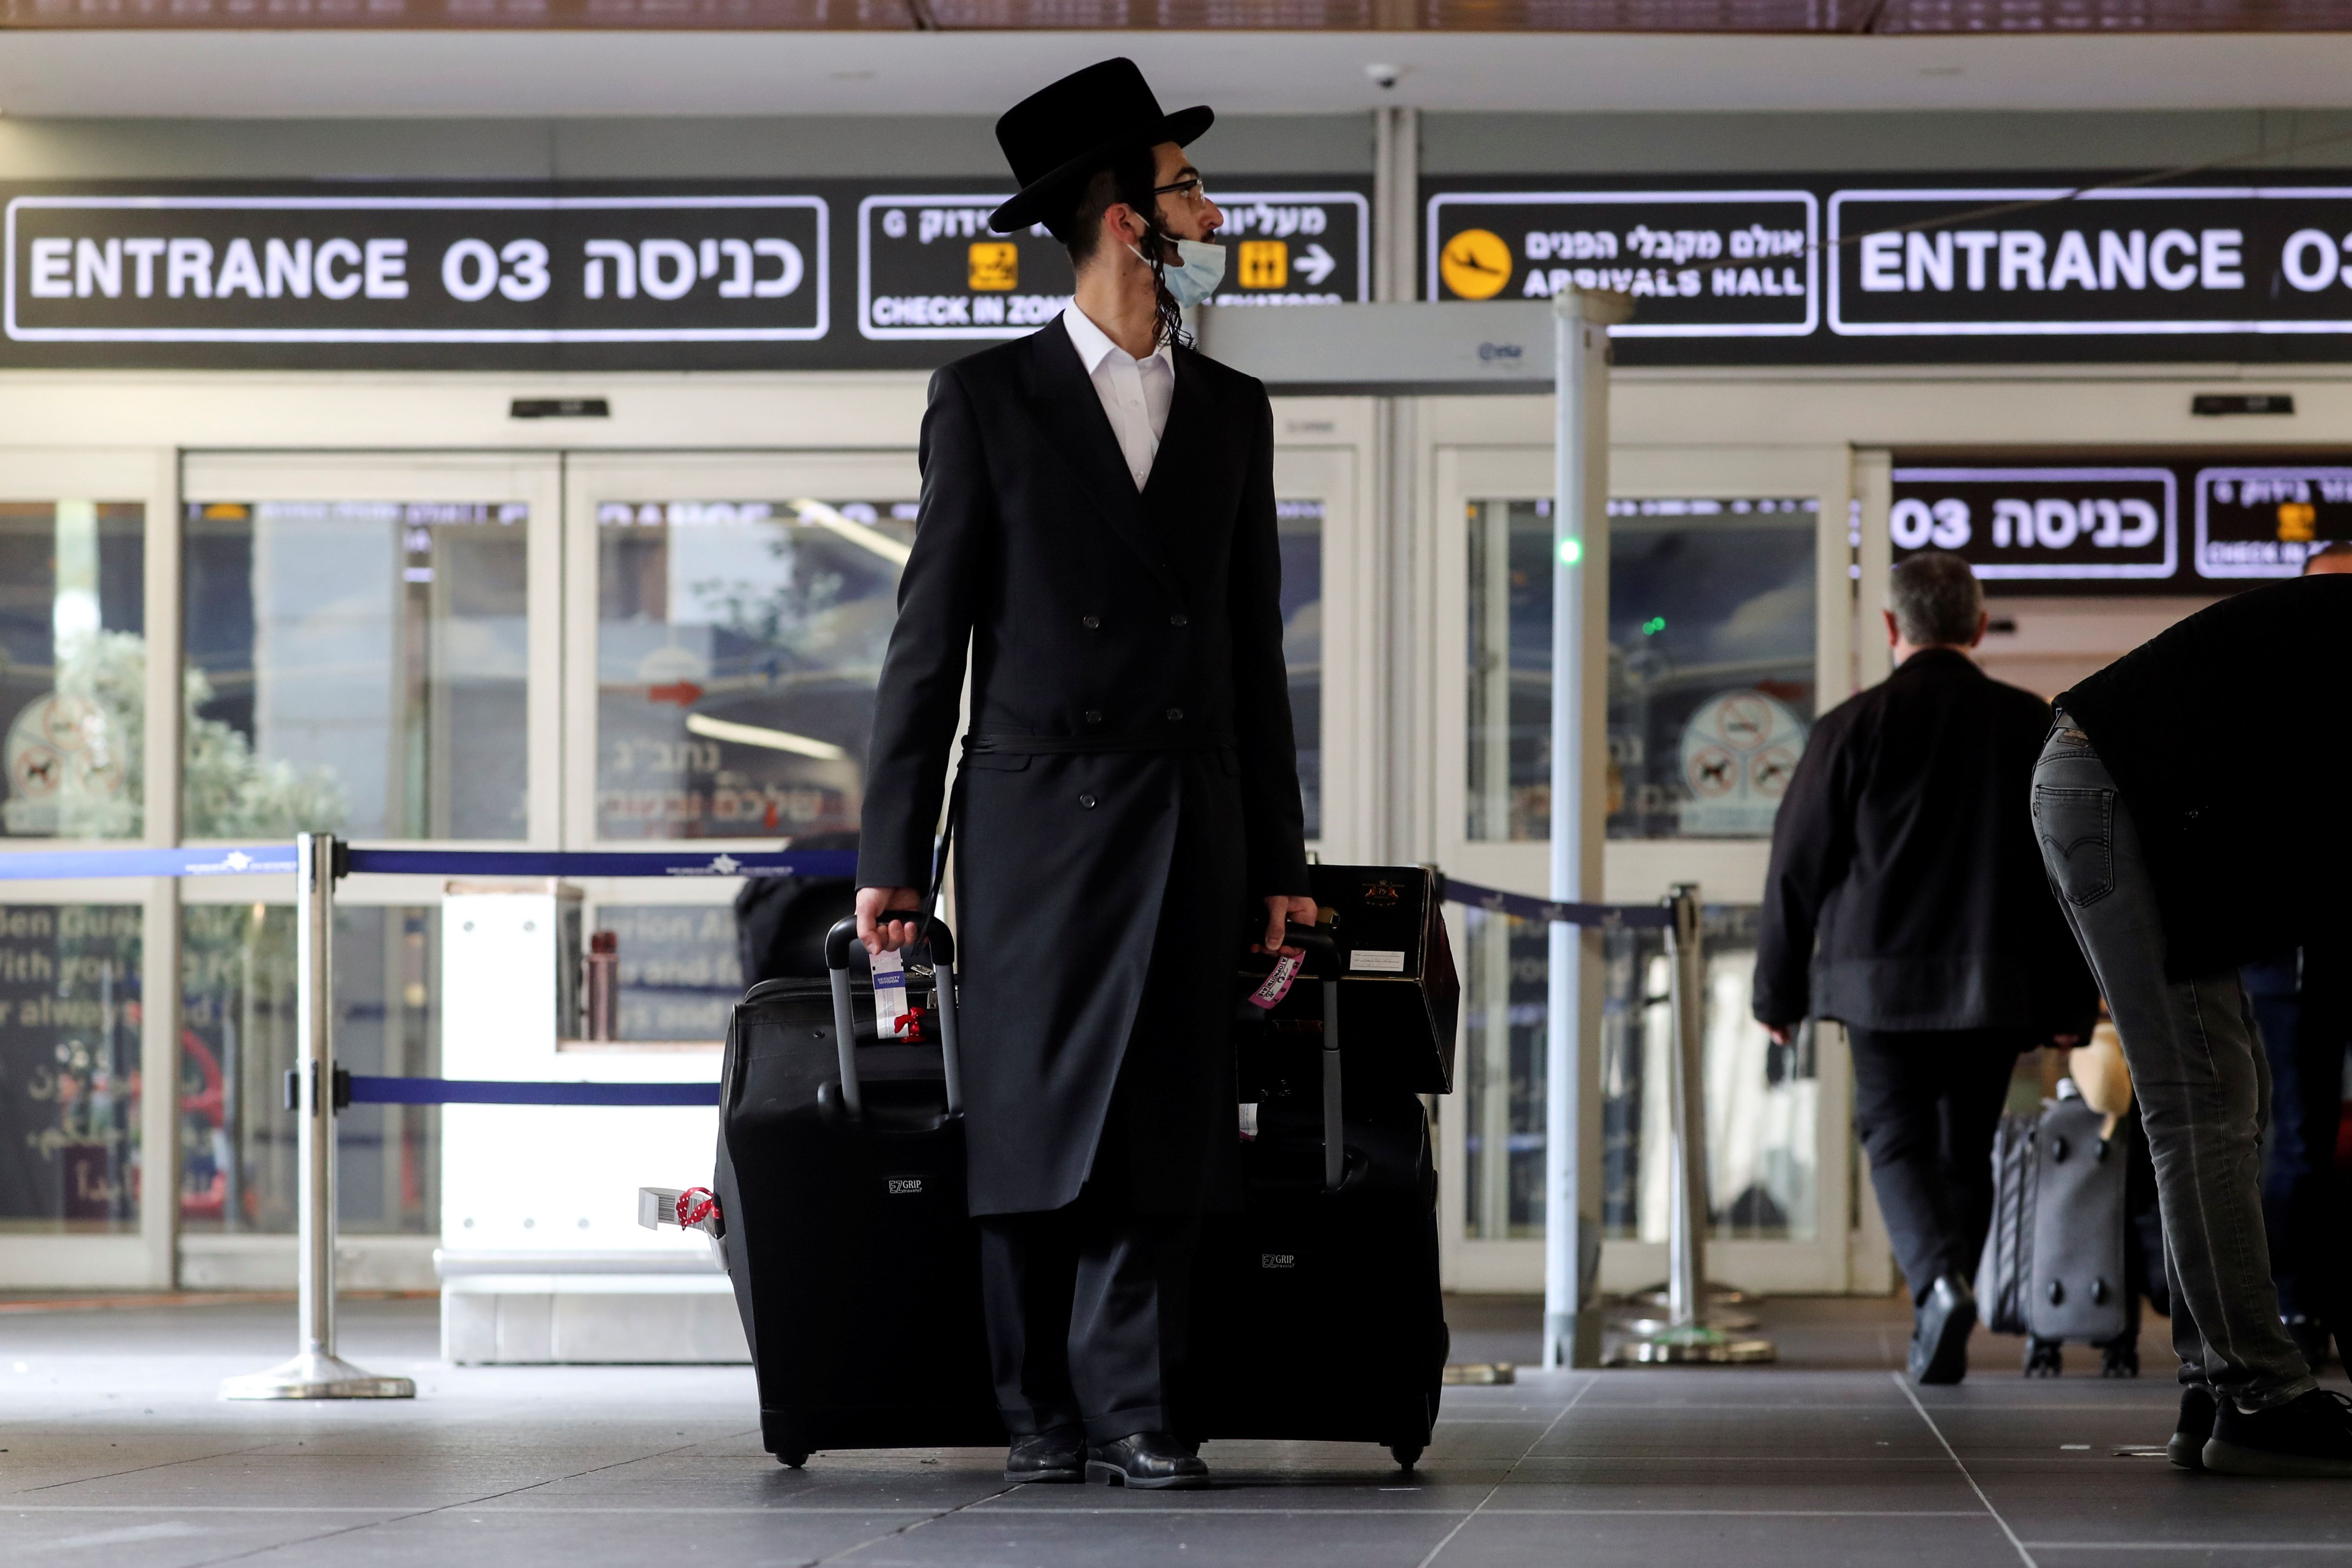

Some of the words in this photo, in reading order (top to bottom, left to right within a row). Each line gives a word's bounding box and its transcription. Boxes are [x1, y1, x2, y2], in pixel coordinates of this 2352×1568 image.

[31, 238, 409, 300] ENTRANCE
[441, 238, 550, 302] 03
[584, 238, 804, 300] כניסה
[1525, 232, 1618, 259] הפנים
[1860, 230, 2244, 291] ENTRANCE
[2282, 228, 2352, 292] 0
[1711, 268, 1805, 296] HALL
[872, 296, 971, 325] CHECK
[972, 296, 1004, 324] IN
[1006, 295, 1071, 324] ZON
[1890, 499, 1971, 549] 03
[1993, 499, 2158, 548] כניסה
